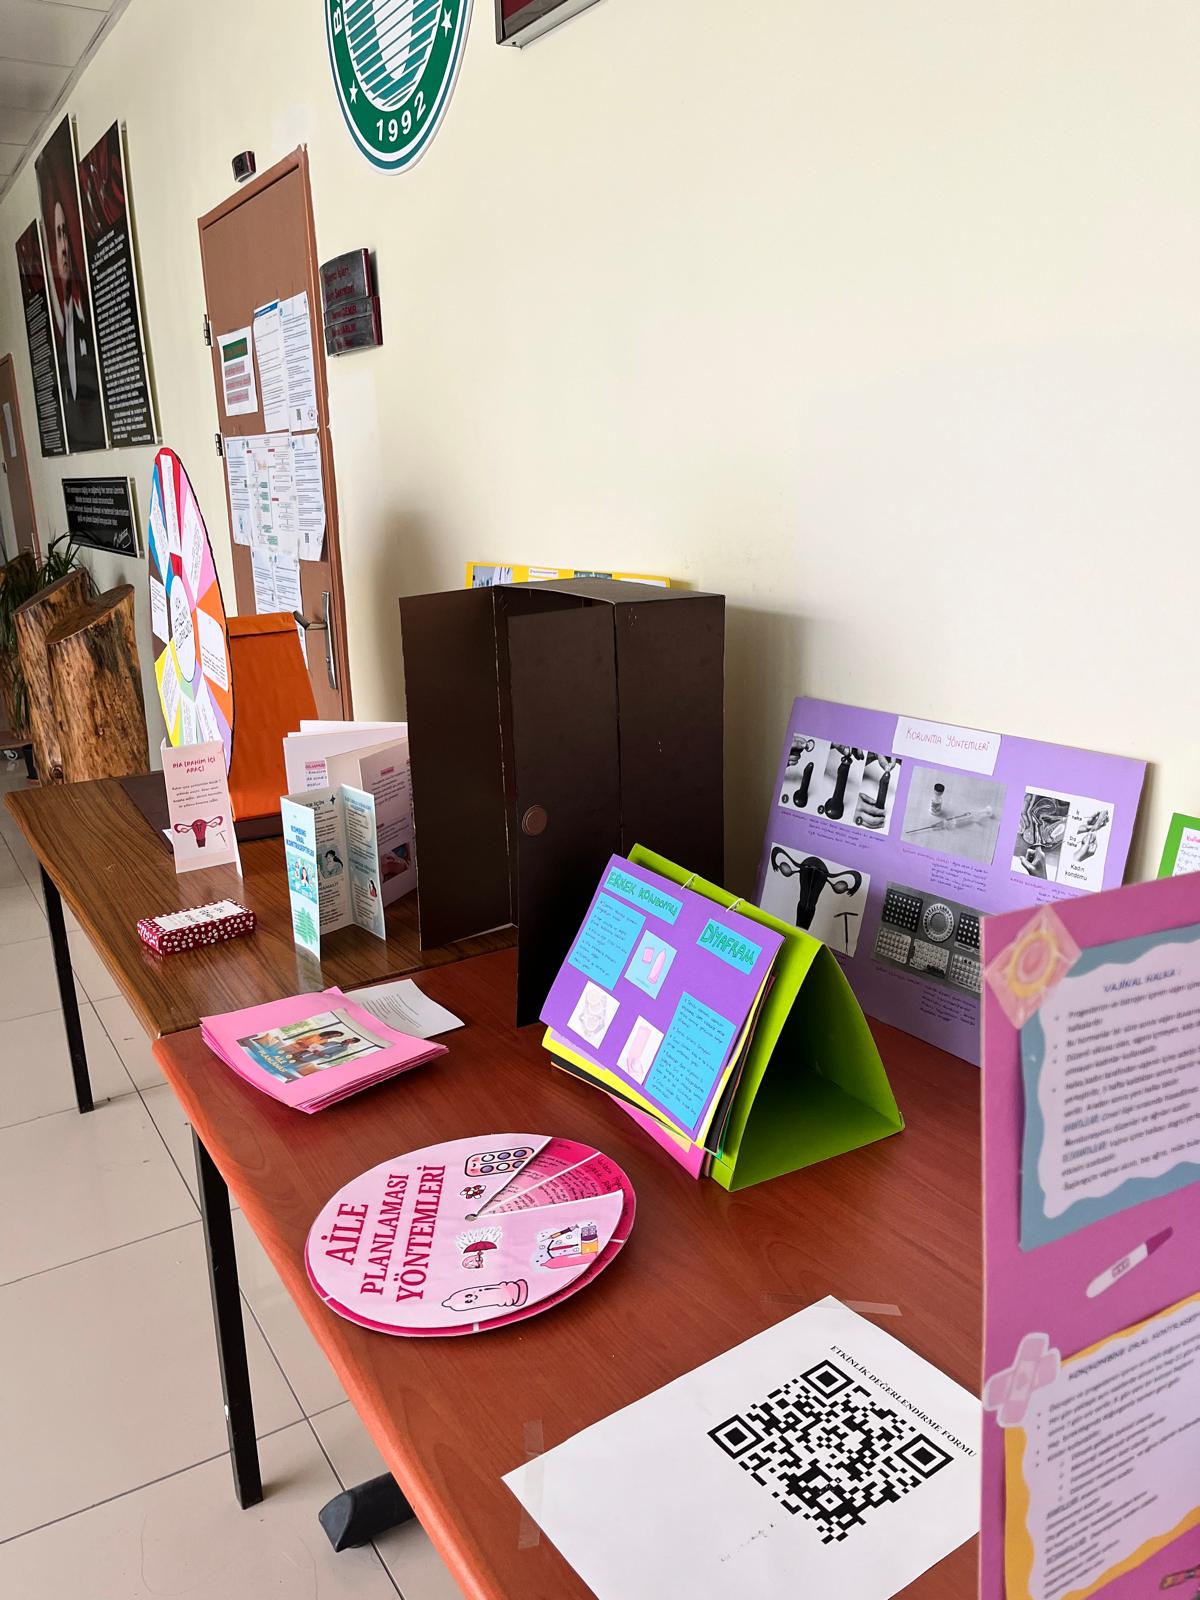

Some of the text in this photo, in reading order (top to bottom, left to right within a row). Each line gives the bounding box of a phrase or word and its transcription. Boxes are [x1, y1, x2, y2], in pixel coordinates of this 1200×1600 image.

[376, 91, 426, 142] 1992
[905, 727, 991, 751] KORUNMA YÖNTEMLERİ
[606, 872, 678, 917] ERKEK KONDOMU
[700, 923, 754, 966] DİYAFRAM
[321, 1203, 369, 1266] AİLE
[360, 1174, 410, 1296] PLANLAMASI
[396, 1164, 447, 1303] YÖNTEMLERİ
[830, 1345, 977, 1458] ETKİNLİK DEĞERLENDİRME FORMU
